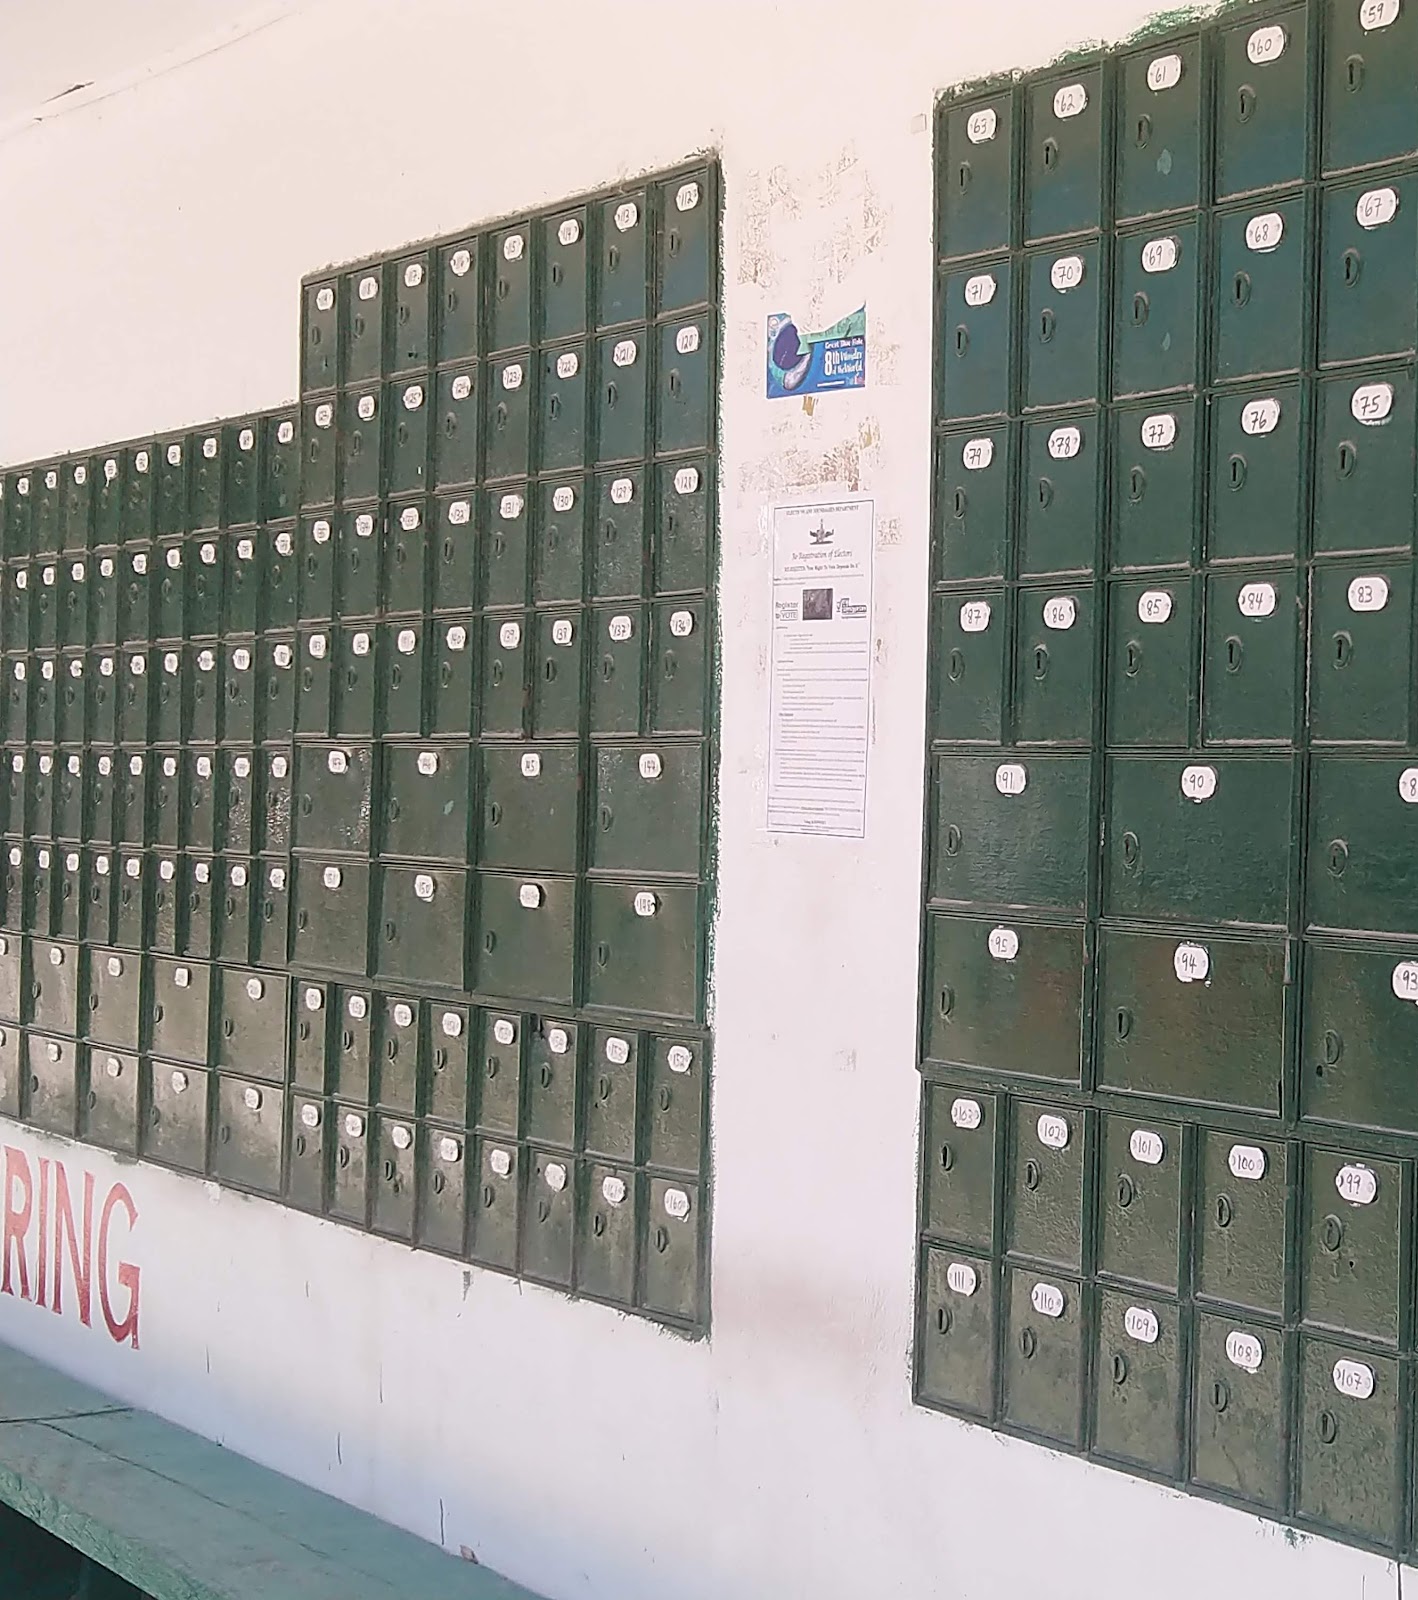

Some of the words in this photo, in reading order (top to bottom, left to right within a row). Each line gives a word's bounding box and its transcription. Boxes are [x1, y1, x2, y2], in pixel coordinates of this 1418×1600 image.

[1367, 3, 1384, 24] 59
[1256, 38, 1272, 56] 60
[1155, 65, 1166, 84] 61
[1060, 93, 1076, 113] 62
[973, 117, 987, 135] 63
[1364, 196, 1383, 218] 67
[1254, 223, 1269, 244] 68
[1148, 244, 1163, 266] 69
[1057, 265, 1074, 284] 70
[971, 283, 983, 301] 71
[1359, 394, 1381, 416] 75
[1250, 409, 1267, 430] 76
[1148, 423, 1165, 443] 77
[1055, 435, 1071, 454] 78
[968, 447, 982, 465] 79
[1247, 592, 1264, 611] 84
[1357, 585, 1373, 604] 83
[967, 608, 982, 625] 87
[1052, 606, 1065, 624] 86
[1146, 598, 1162, 617] 85
[1002, 771, 1013, 790] 91
[1189, 773, 1204, 791] 90
[995, 935, 1008, 953] 95
[1181, 952, 1198, 974] 94
[1402, 969, 1418, 991] 93
[1044, 1122, 1061, 1142] 102
[1138, 1135, 1152, 1156] 101
[1237, 1154, 1255, 1172] 100
[1346, 1172, 1362, 1195] 99
[1, 1145, 141, 1350] RING
[954, 1271, 965, 1289] 111
[1040, 1291, 1054, 1311] 110
[1131, 1315, 1150, 1337] 109
[1233, 1339, 1253, 1363] 108
[1341, 1368, 1363, 1391] 107
